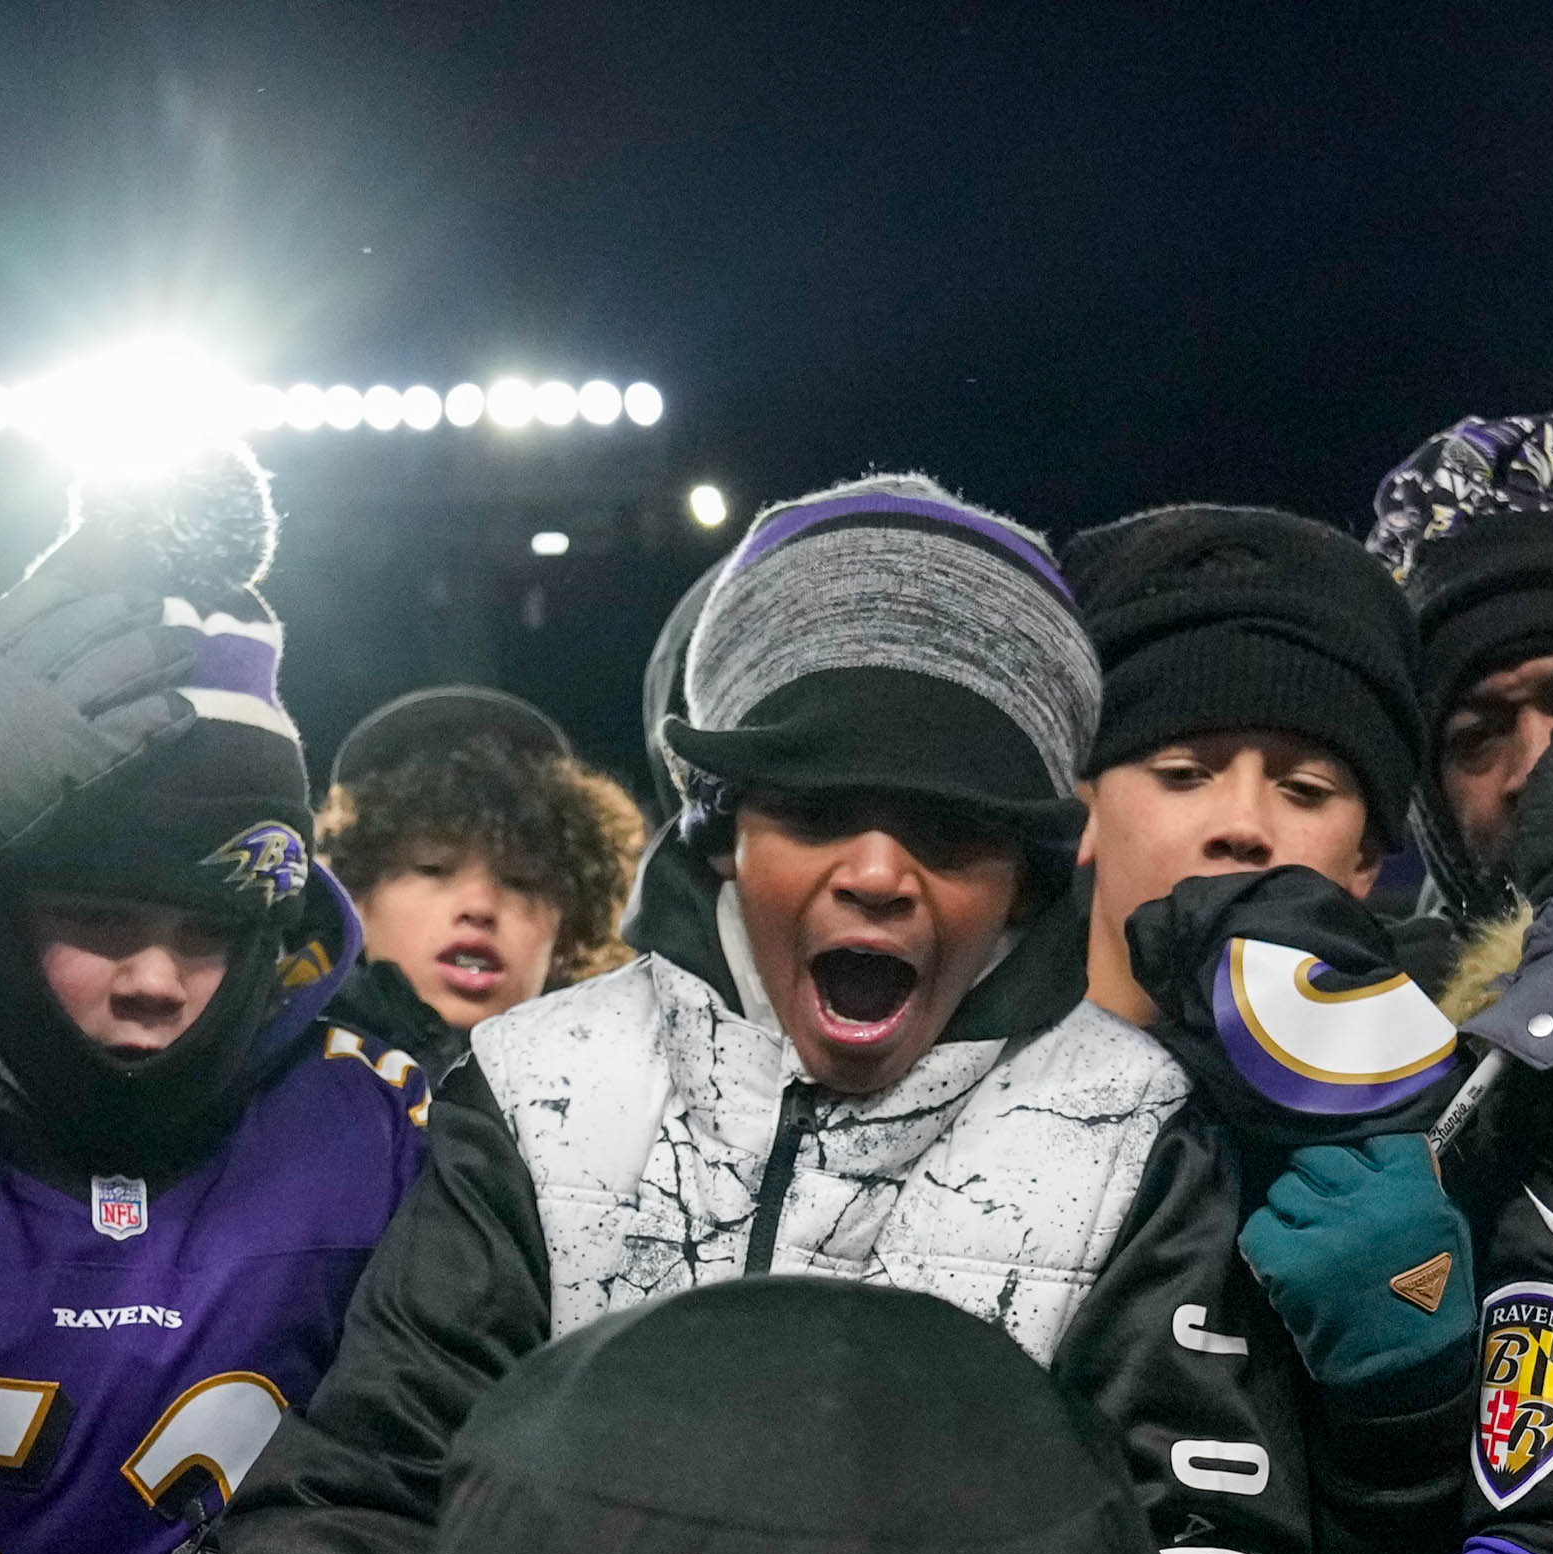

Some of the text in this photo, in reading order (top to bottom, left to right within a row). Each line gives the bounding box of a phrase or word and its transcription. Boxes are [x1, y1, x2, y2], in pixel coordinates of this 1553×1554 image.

[1428, 1102, 1471, 1153] Sharpie
[102, 1202, 140, 1227] NFL
[52, 1304, 183, 1331] RAVENS
